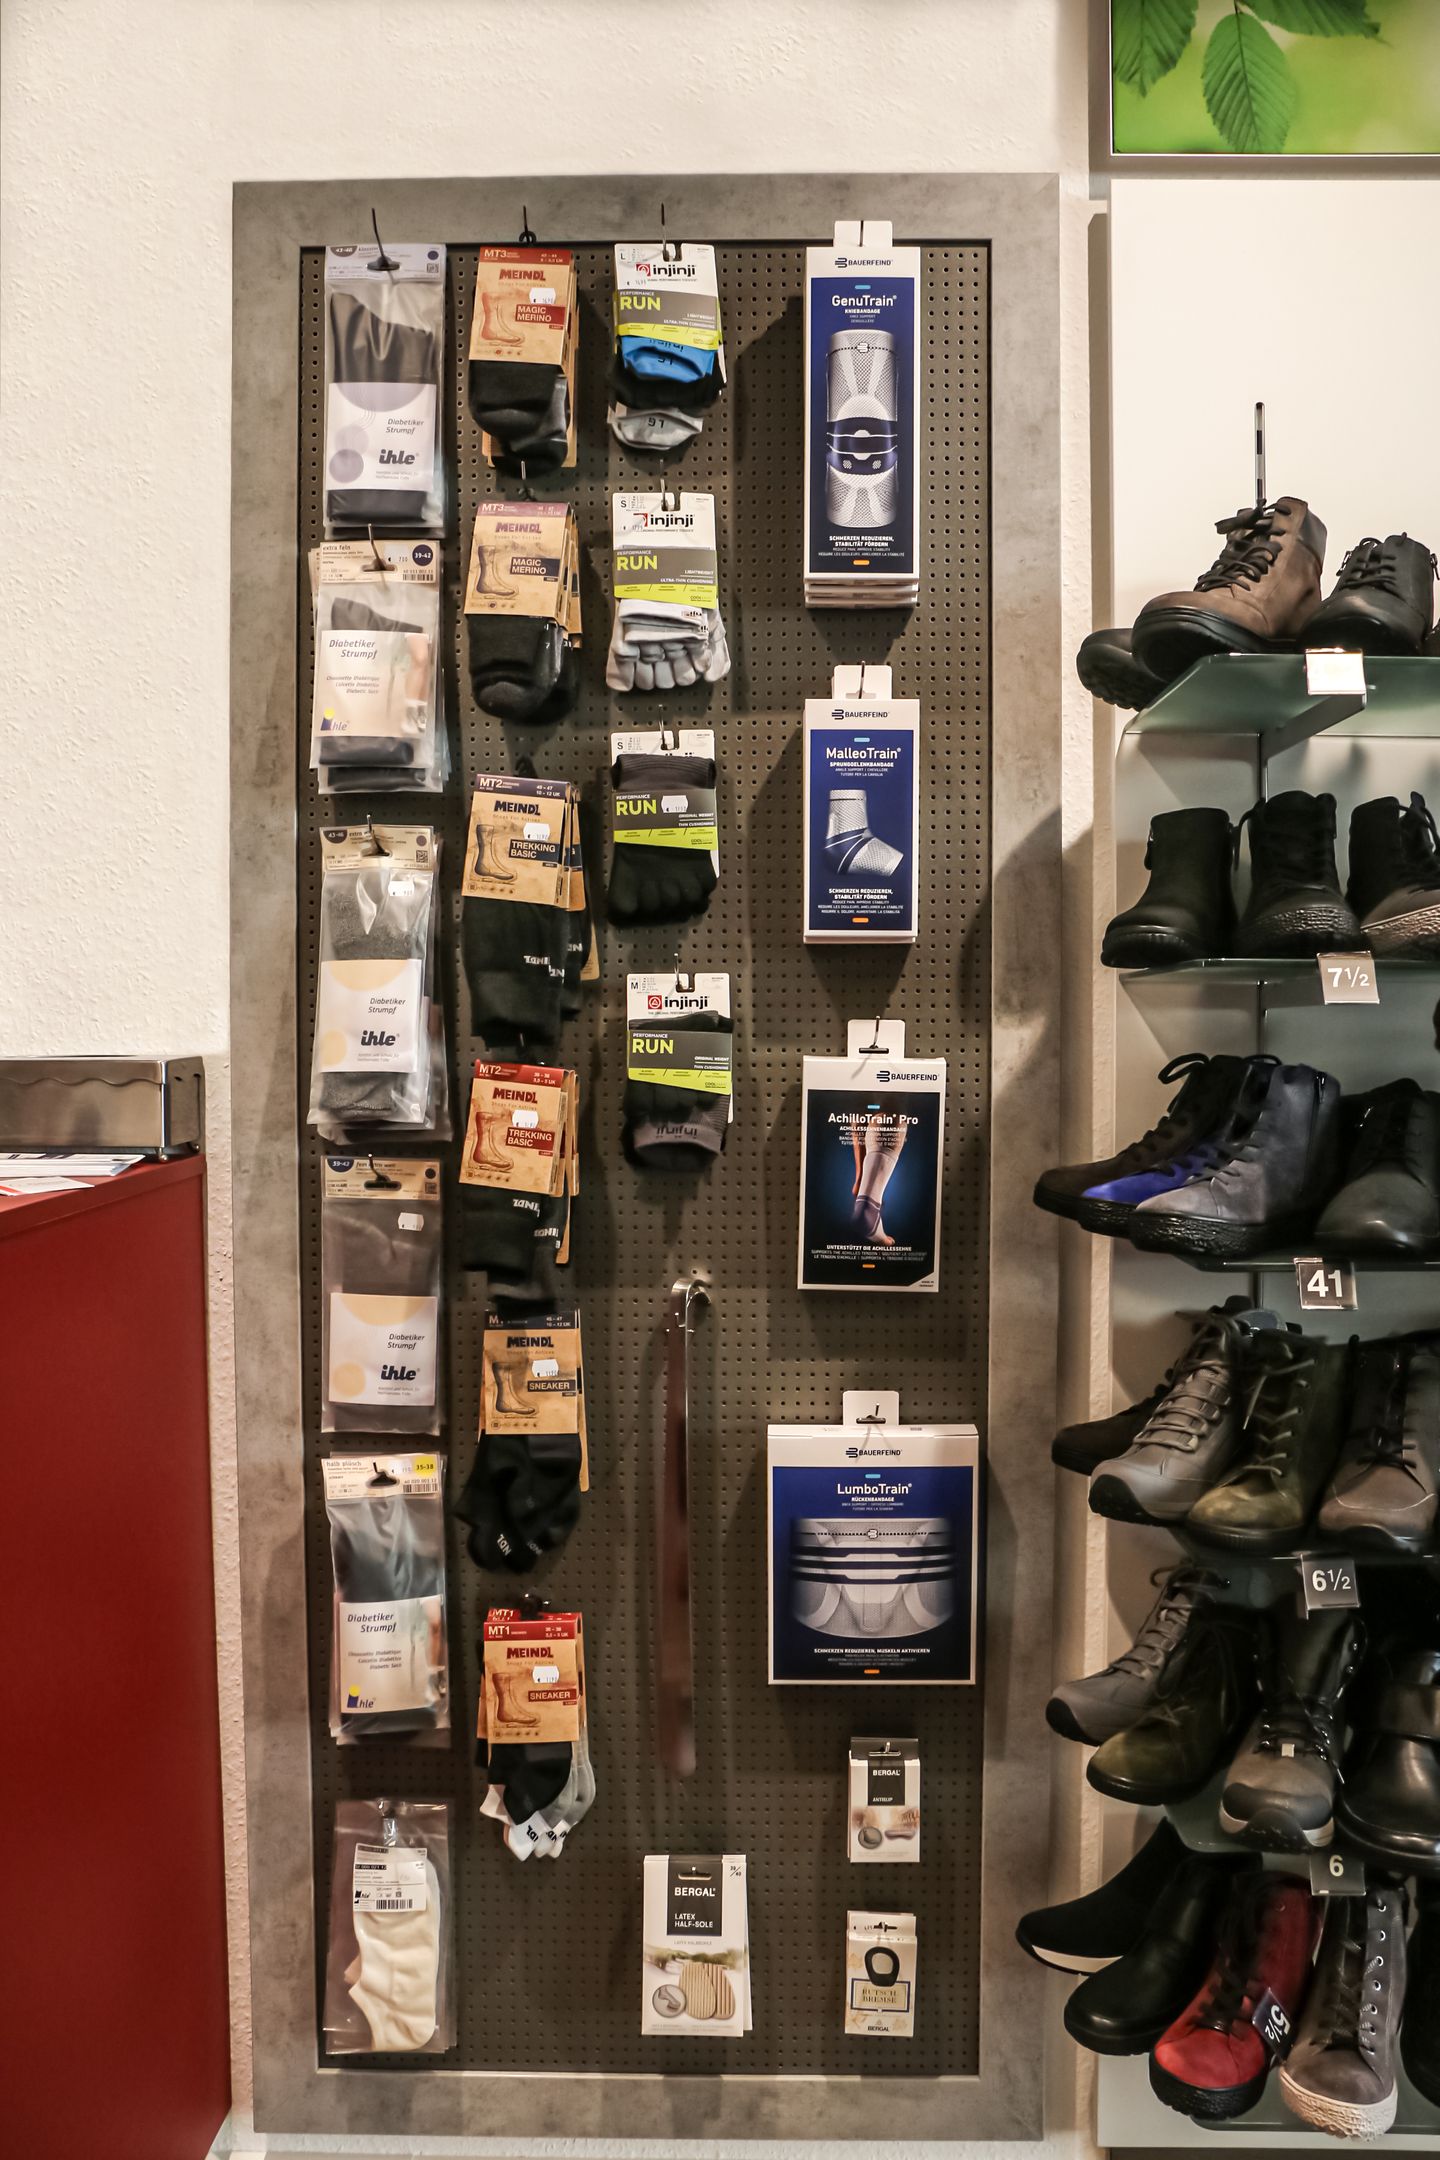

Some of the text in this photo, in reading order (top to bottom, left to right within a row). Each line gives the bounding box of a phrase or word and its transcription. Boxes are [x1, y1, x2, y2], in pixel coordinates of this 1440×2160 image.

[484, 249, 507, 258] MT3
[499, 269, 546, 281] MEINDL
[653, 264, 696, 277] injinji
[620, 296, 661, 311] RUN
[517, 305, 547, 314] MAGIC
[517, 314, 552, 322] MERINO
[387, 418, 424, 426] Diabetiker
[386, 426, 416, 435] Strumpf
[379, 449, 416, 465] ihle
[482, 503, 504, 512] MT3
[620, 500, 627, 508] S
[650, 514, 694, 527] injinji
[495, 522, 542, 534] MEINDL
[512, 558, 542, 566] MAGIC
[617, 555, 658, 571] RUN
[511, 566, 547, 575] MERINO
[329, 640, 376, 648] Diabetiker
[341, 649, 378, 660] Strumpf
[617, 742, 624, 750] S
[480, 778, 503, 788] MT2
[494, 800, 541, 816] MEINDL
[616, 799, 657, 816] RUN
[511, 841, 556, 853] TREKKING
[510, 849, 537, 859] BASIC
[631, 982, 639, 990] M
[370, 997, 406, 1005] Diabetiker
[664, 996, 709, 1010] injinji
[368, 1006, 397, 1015] Strumpf
[361, 1030, 396, 1046] ihle
[632, 1039, 674, 1055] RUN
[480, 1064, 502, 1074] MT2
[891, 1073, 938, 1081] BAUERFEIND
[493, 1087, 538, 1104] MEINDL
[899, 1114, 919, 1125] Pro
[509, 1129, 552, 1141] TREKKING
[507, 1137, 533, 1147] BASIC
[1307, 1269, 1343, 1298] 41
[389, 1333, 425, 1341] Diabetiker
[507, 1336, 554, 1348] MEINDL
[387, 1341, 417, 1350] Strumpf
[380, 1364, 417, 1381] ihle
[529, 1382, 570, 1390] SNEAKER
[347, 1613, 394, 1622] Diabetiker
[361, 1622, 397, 1633] Strumpf
[488, 1626, 510, 1635] MT1
[507, 1647, 554, 1659] MEINDL
[530, 1691, 571, 1700] SNEAKER
[1329, 1854, 1344, 1877] 6
[674, 1920, 713, 1928] HALF-SOLE
[862, 1988, 897, 1997] RUTSCH
[863, 1996, 897, 2004] BREMSE
